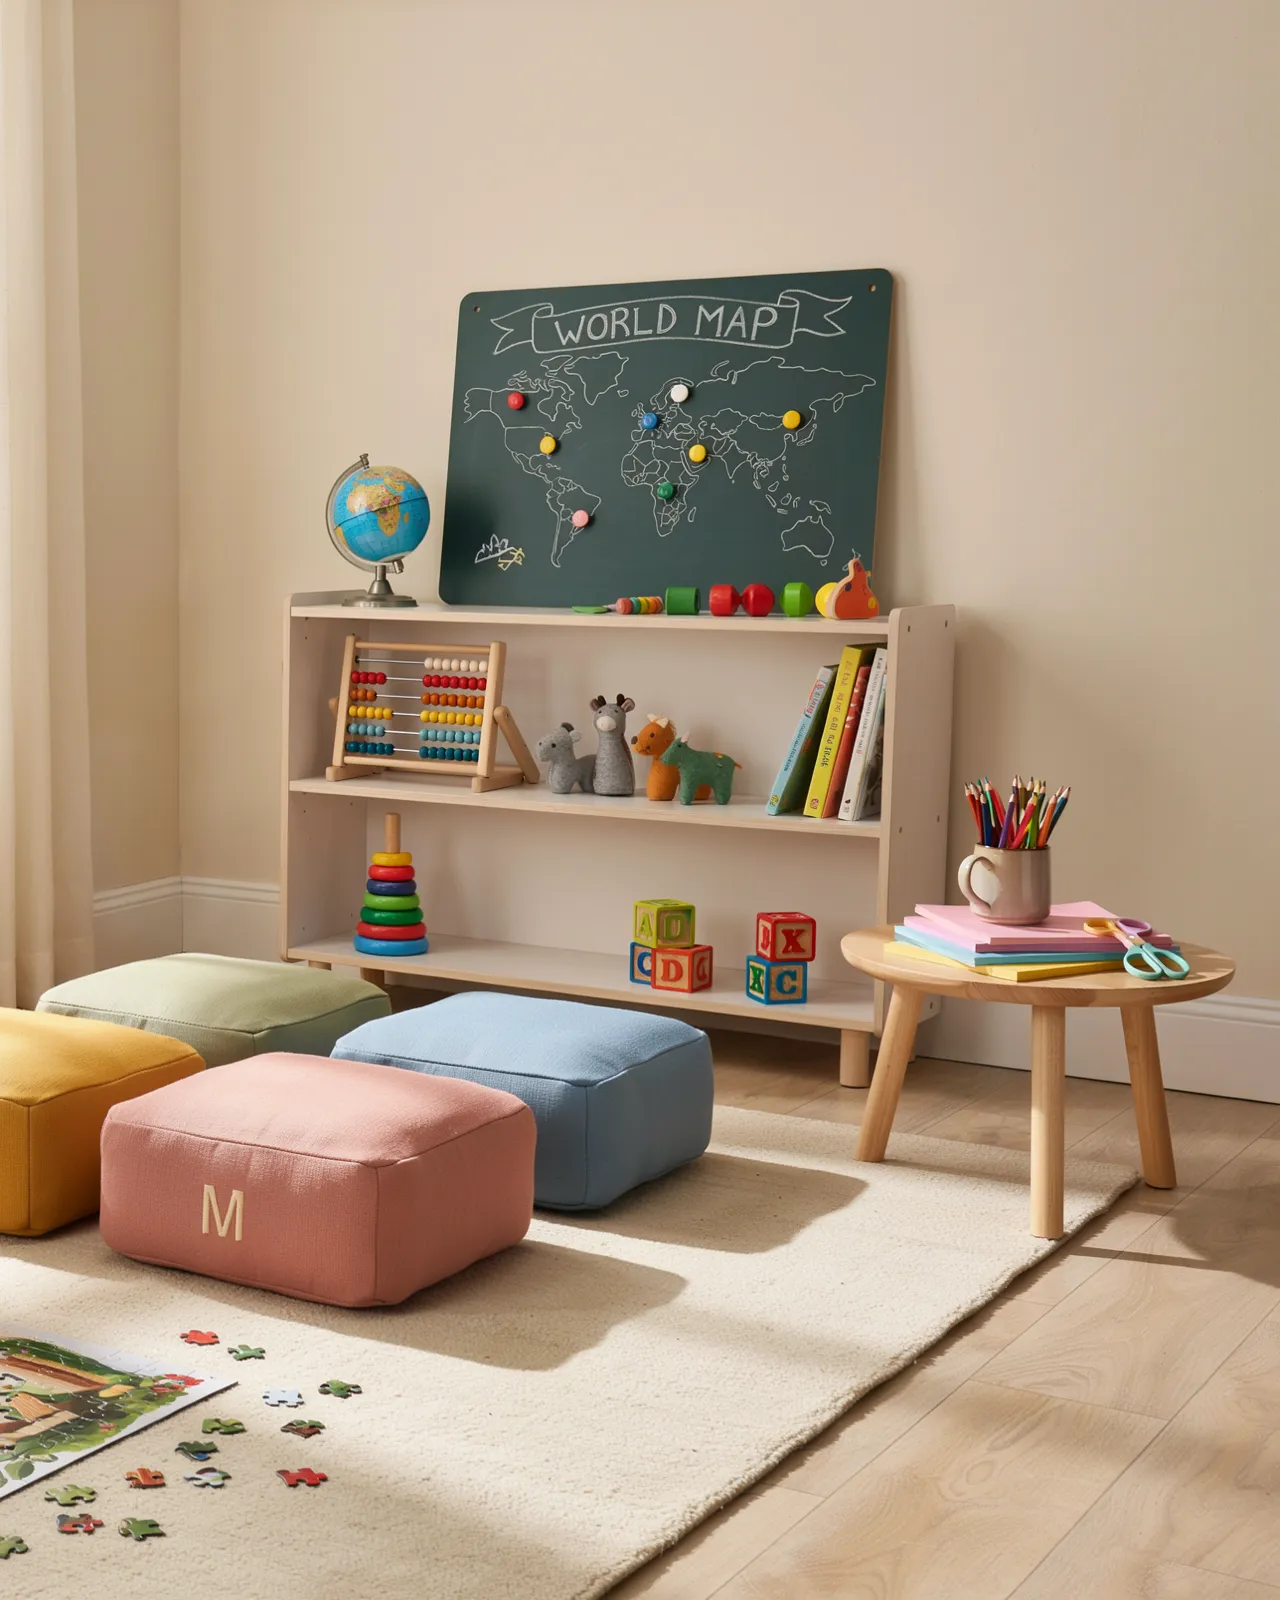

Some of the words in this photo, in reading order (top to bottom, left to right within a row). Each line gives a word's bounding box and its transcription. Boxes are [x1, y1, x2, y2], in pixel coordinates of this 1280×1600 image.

[554, 303, 677, 346] WORLD
[694, 304, 778, 341] MAP
[639, 913, 654, 938] A
[781, 929, 806, 954] X
[661, 958, 684, 982] D
[775, 969, 797, 995] C
[201, 1184, 244, 1241] M
